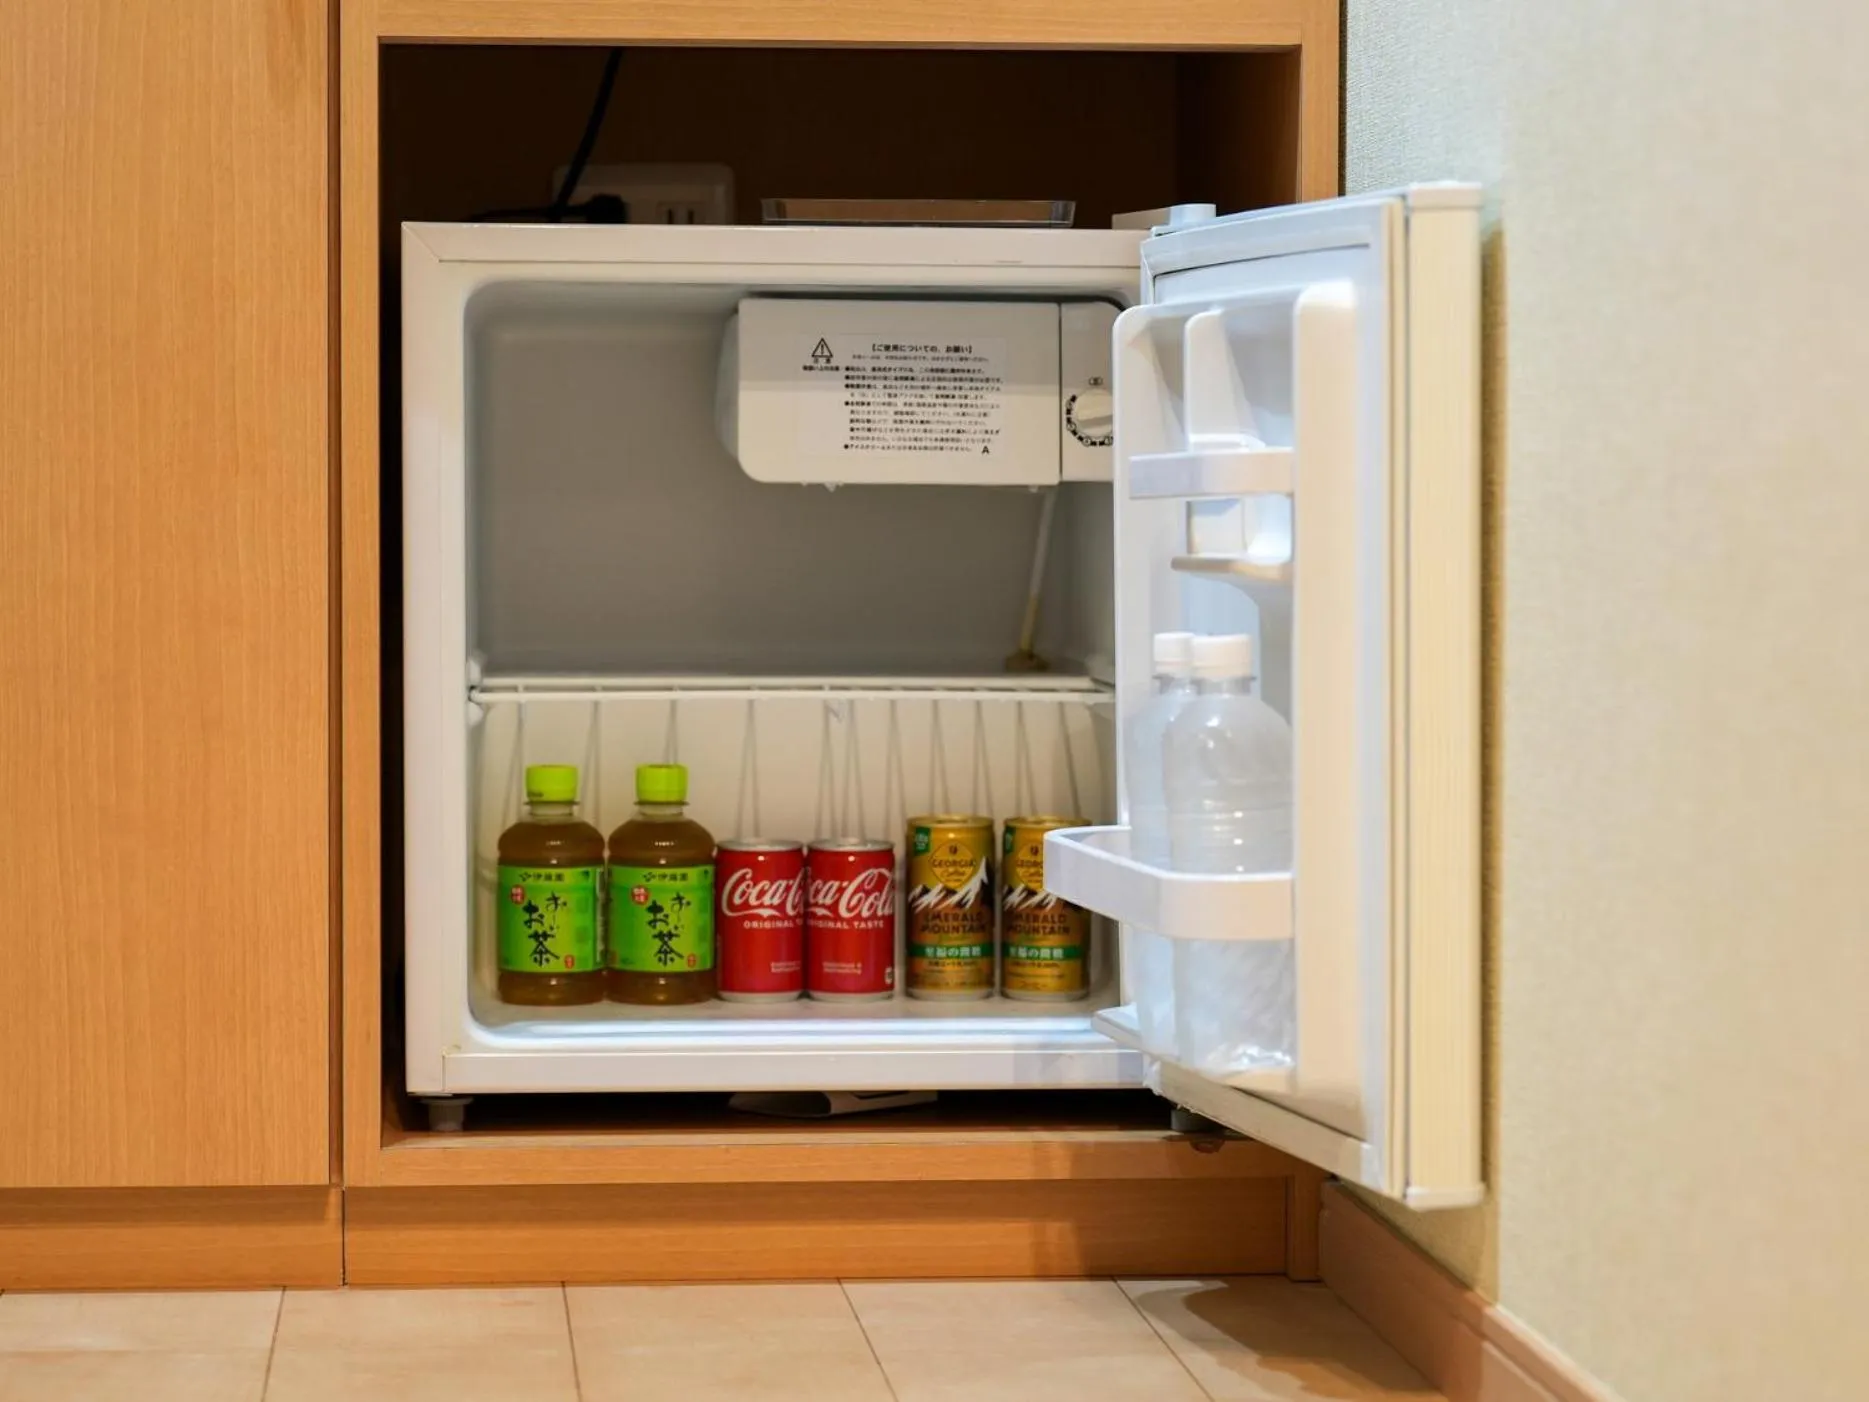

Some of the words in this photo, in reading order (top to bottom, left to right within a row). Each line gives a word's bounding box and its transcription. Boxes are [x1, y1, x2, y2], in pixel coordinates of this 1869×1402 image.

[981, 446, 990, 454] A
[743, 919, 794, 930] ORIGINAL
[853, 920, 884, 930] TASTE
